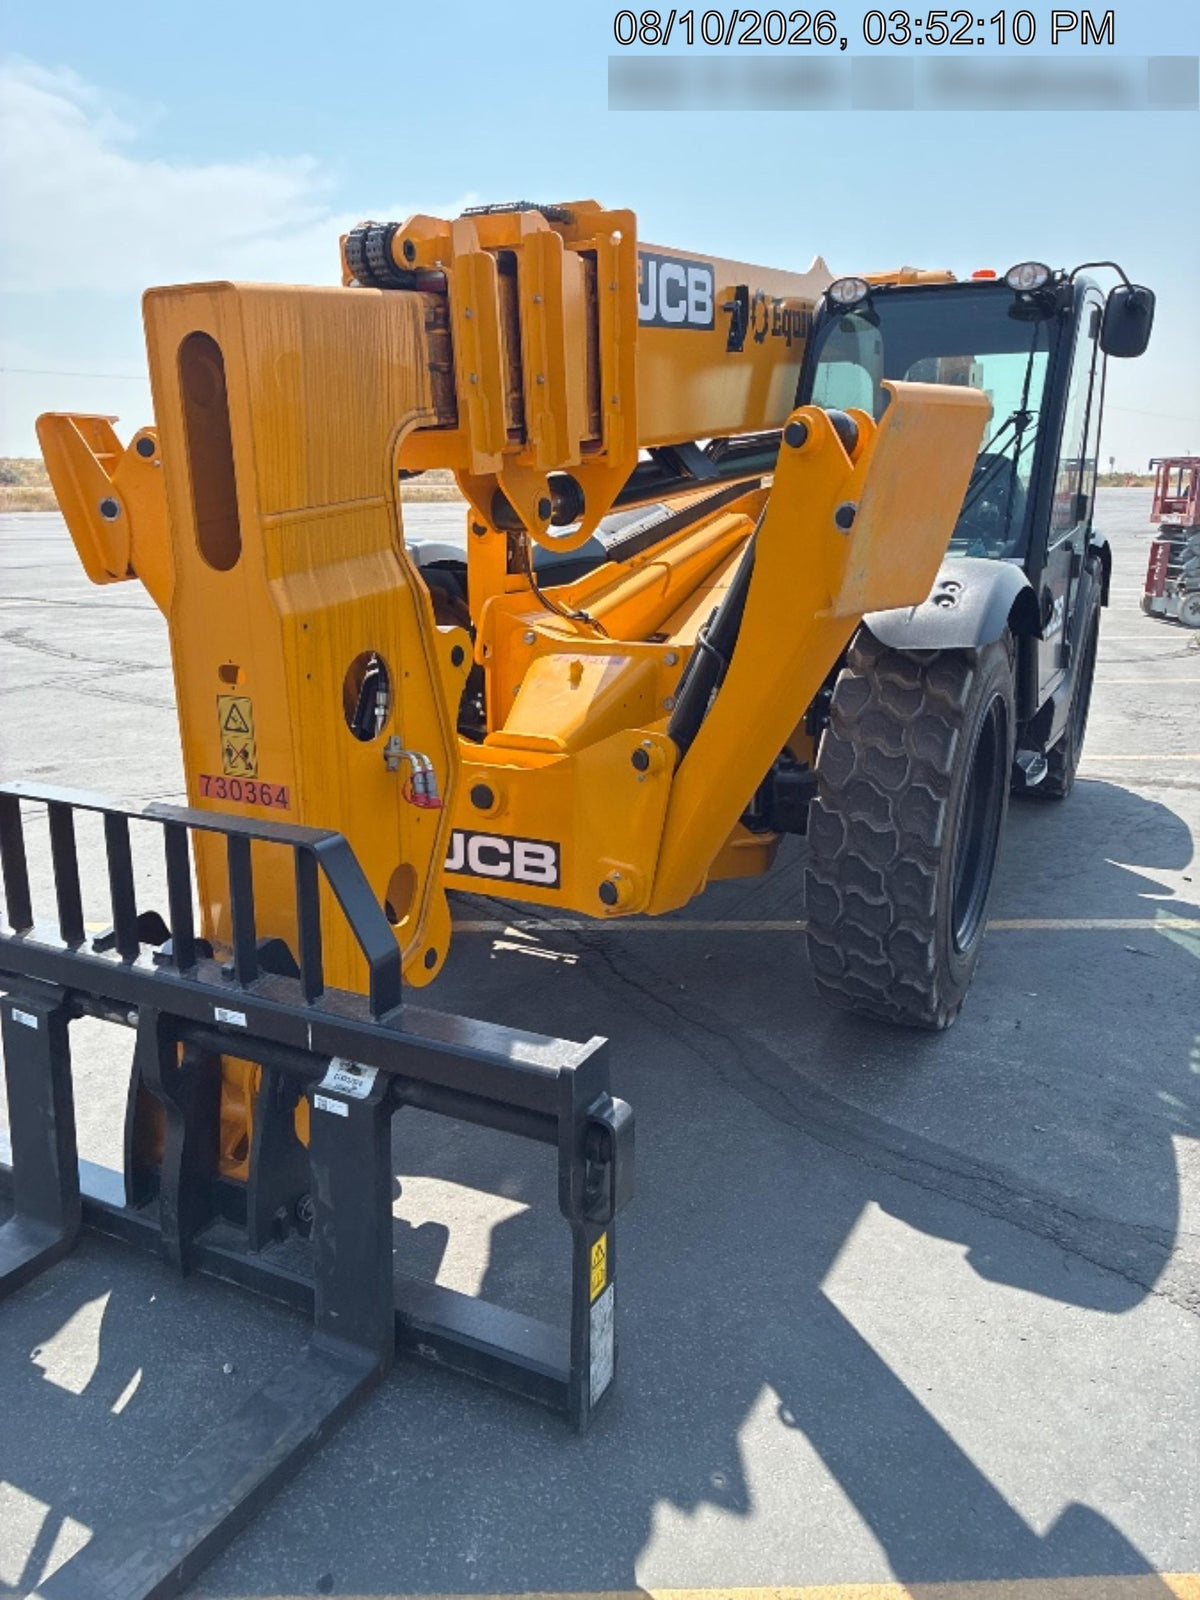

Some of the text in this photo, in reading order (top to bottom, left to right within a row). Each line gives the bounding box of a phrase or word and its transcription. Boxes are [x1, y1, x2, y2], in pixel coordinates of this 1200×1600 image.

[638, 260, 713, 324] JCB
[200, 774, 289, 809] 730364
[443, 832, 558, 884] JCB
